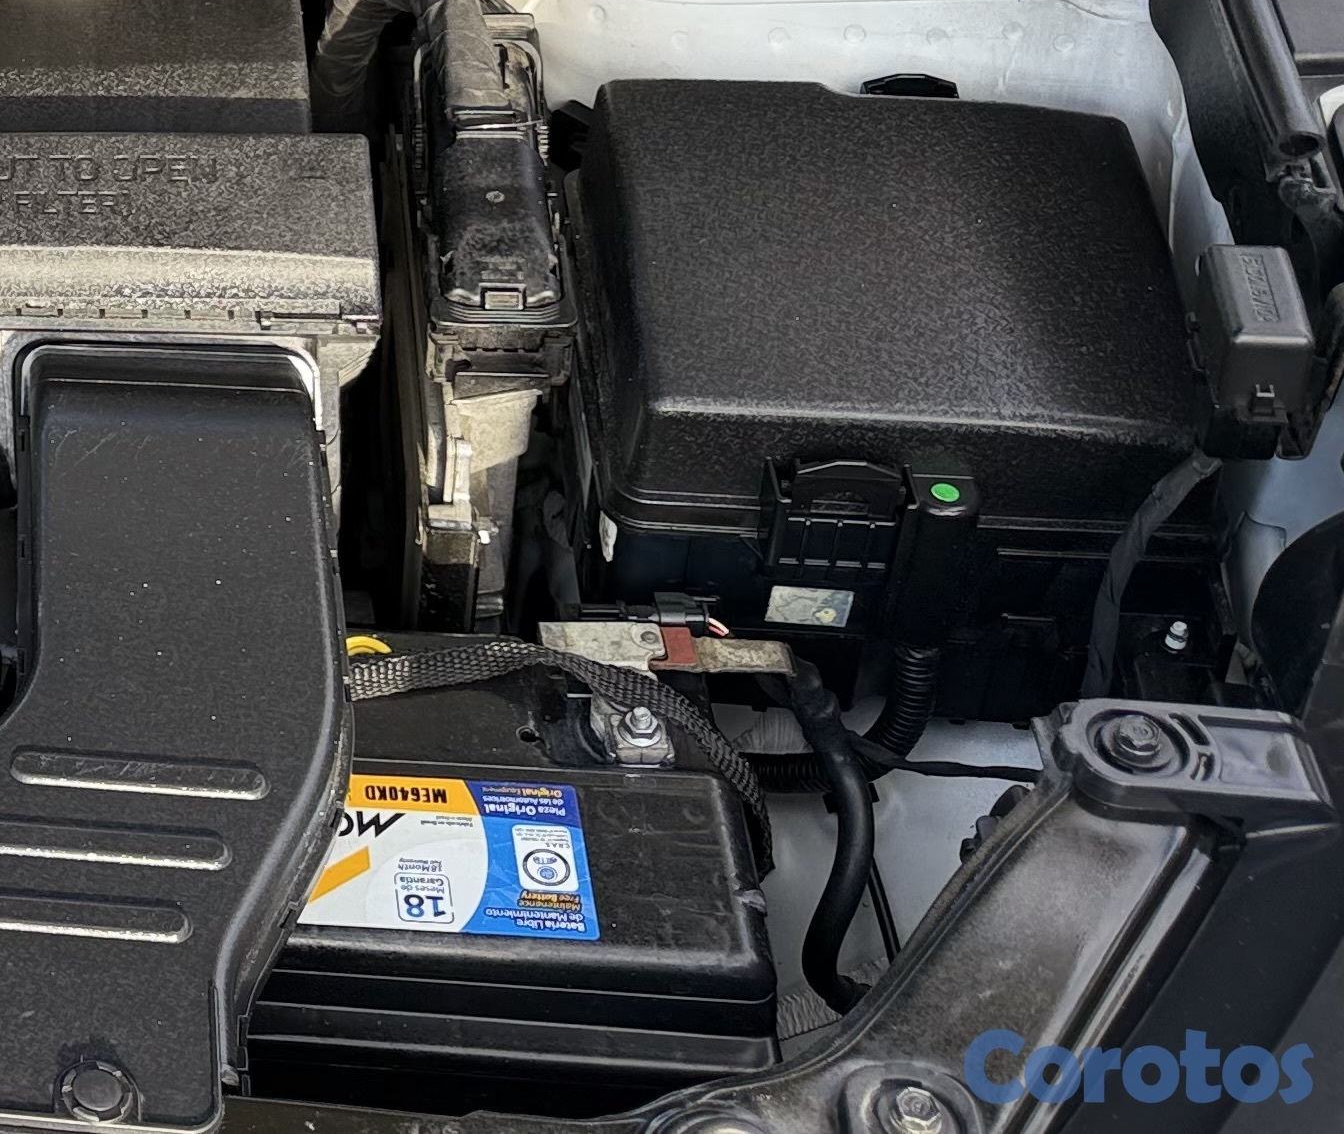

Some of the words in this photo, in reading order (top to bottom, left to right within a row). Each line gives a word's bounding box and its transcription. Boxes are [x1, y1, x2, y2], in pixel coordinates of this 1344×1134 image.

[365, 785, 446, 803] ME640KD
[522, 788, 562, 798] Original
[484, 802, 536, 816] Original
[415, 885, 444, 894] Meses
[520, 891, 558, 902] Battery
[404, 895, 446, 917] 18
